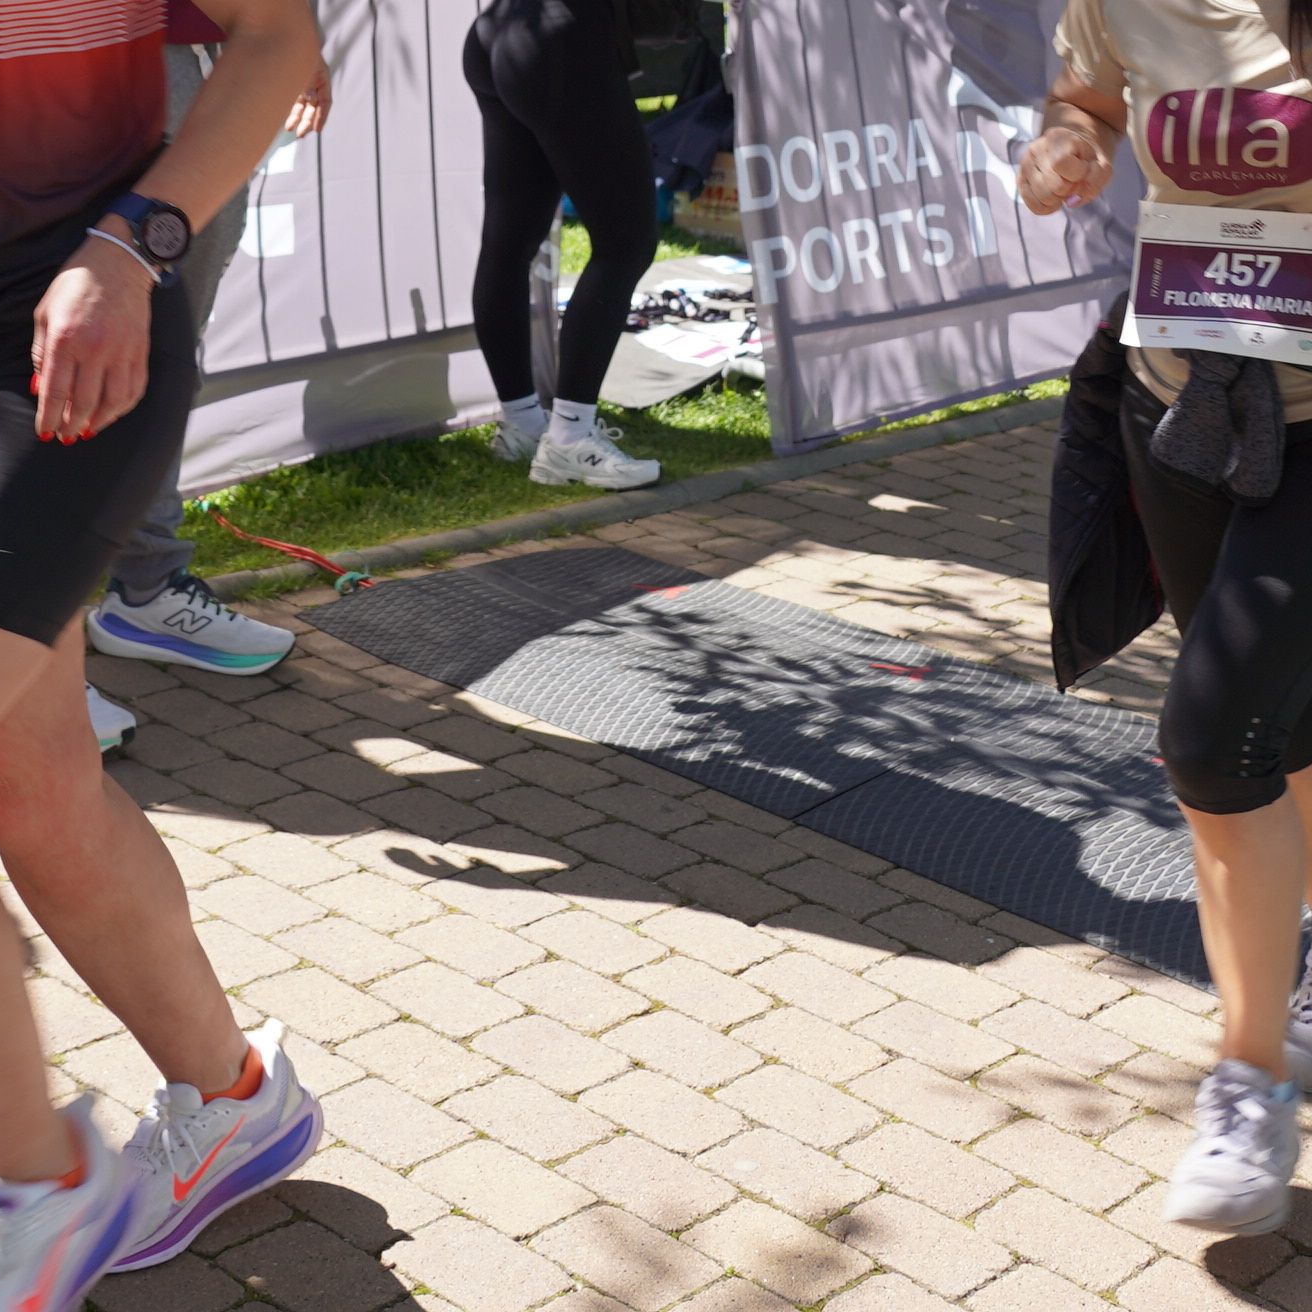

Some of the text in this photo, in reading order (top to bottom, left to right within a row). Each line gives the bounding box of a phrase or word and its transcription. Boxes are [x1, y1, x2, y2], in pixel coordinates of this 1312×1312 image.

[1161, 87, 1290, 168] illa
[735, 118, 943, 213] DORRA
[1190, 170, 1289, 184] CARLEMANY
[751, 197, 955, 305] PORTS
[1203, 251, 1282, 288] 457
[163, 569, 213, 604] N
